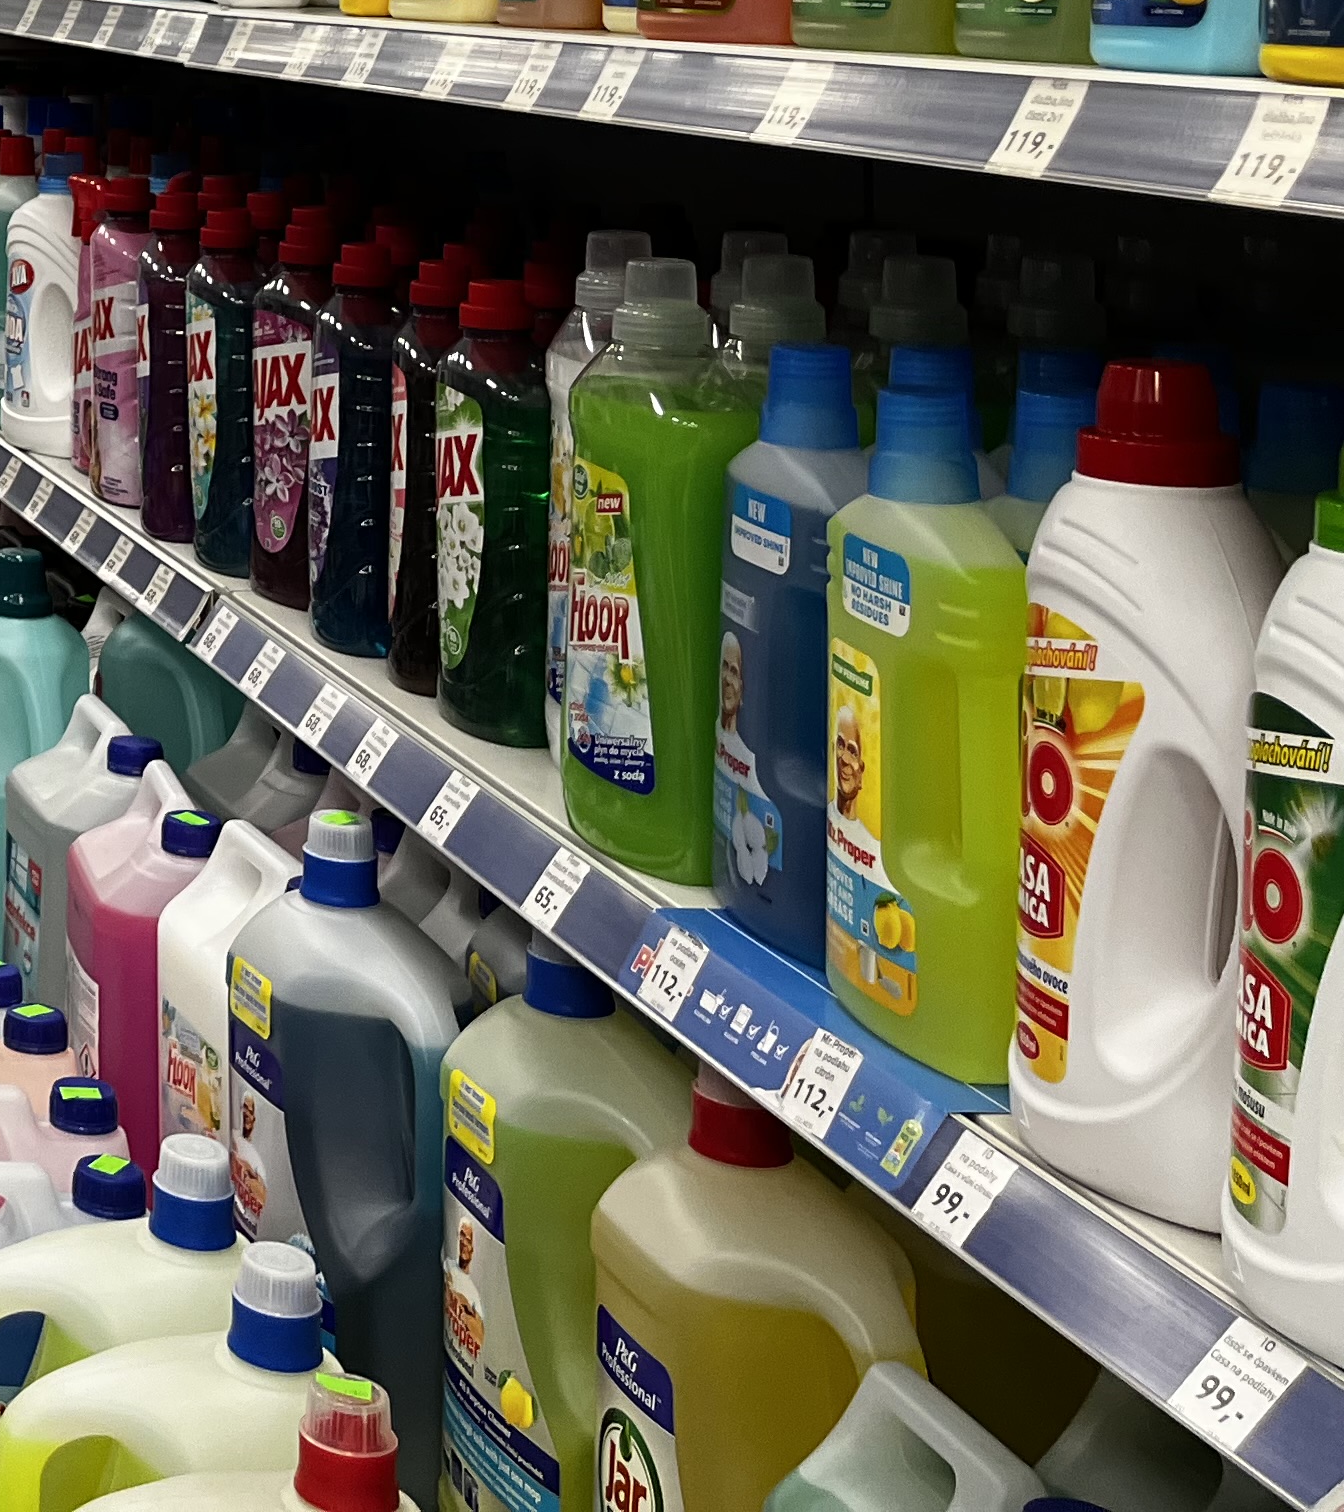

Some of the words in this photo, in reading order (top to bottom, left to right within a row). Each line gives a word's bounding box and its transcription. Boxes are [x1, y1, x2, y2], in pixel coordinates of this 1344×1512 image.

[768, 104, 807, 130] 119,-
[1003, 128, 1058, 159] 119,-
[1233, 151, 1298, 186] 119,-
[597, 496, 621, 512] new
[746, 499, 767, 524] NEW
[862, 546, 879, 566] NEW
[850, 583, 863, 598] NO
[863, 589, 892, 613] HARSH
[878, 575, 906, 599] SHINE
[569, 574, 630, 660] FLOOR
[850, 600, 890, 627] RESIDUES
[593, 734, 647, 749] Uniwersalny
[609, 746, 619, 756] do
[620, 746, 645, 759] mycia
[354, 748, 374, 772] 68,-
[613, 771, 620, 781] z
[621, 769, 646, 785] sodą
[429, 805, 452, 831] 65,-
[535, 886, 559, 913] 65,-
[649, 962, 683, 1003] 112,-
[167, 1044, 197, 1105] FLOOR
[792, 1077, 835, 1119] 112,-
[463, 1166, 481, 1193] P&G
[451, 1171, 491, 1219] Professional
[931, 1183, 971, 1226] 99,-
[616, 1337, 640, 1373] P&G
[1210, 1348, 1231, 1368] Casa
[1231, 1364, 1243, 1377] na
[1243, 1348, 1254, 1361] se
[600, 1342, 659, 1411] Professional
[1195, 1374, 1244, 1424] 99,-
[605, 1451, 648, 1510] Jar
